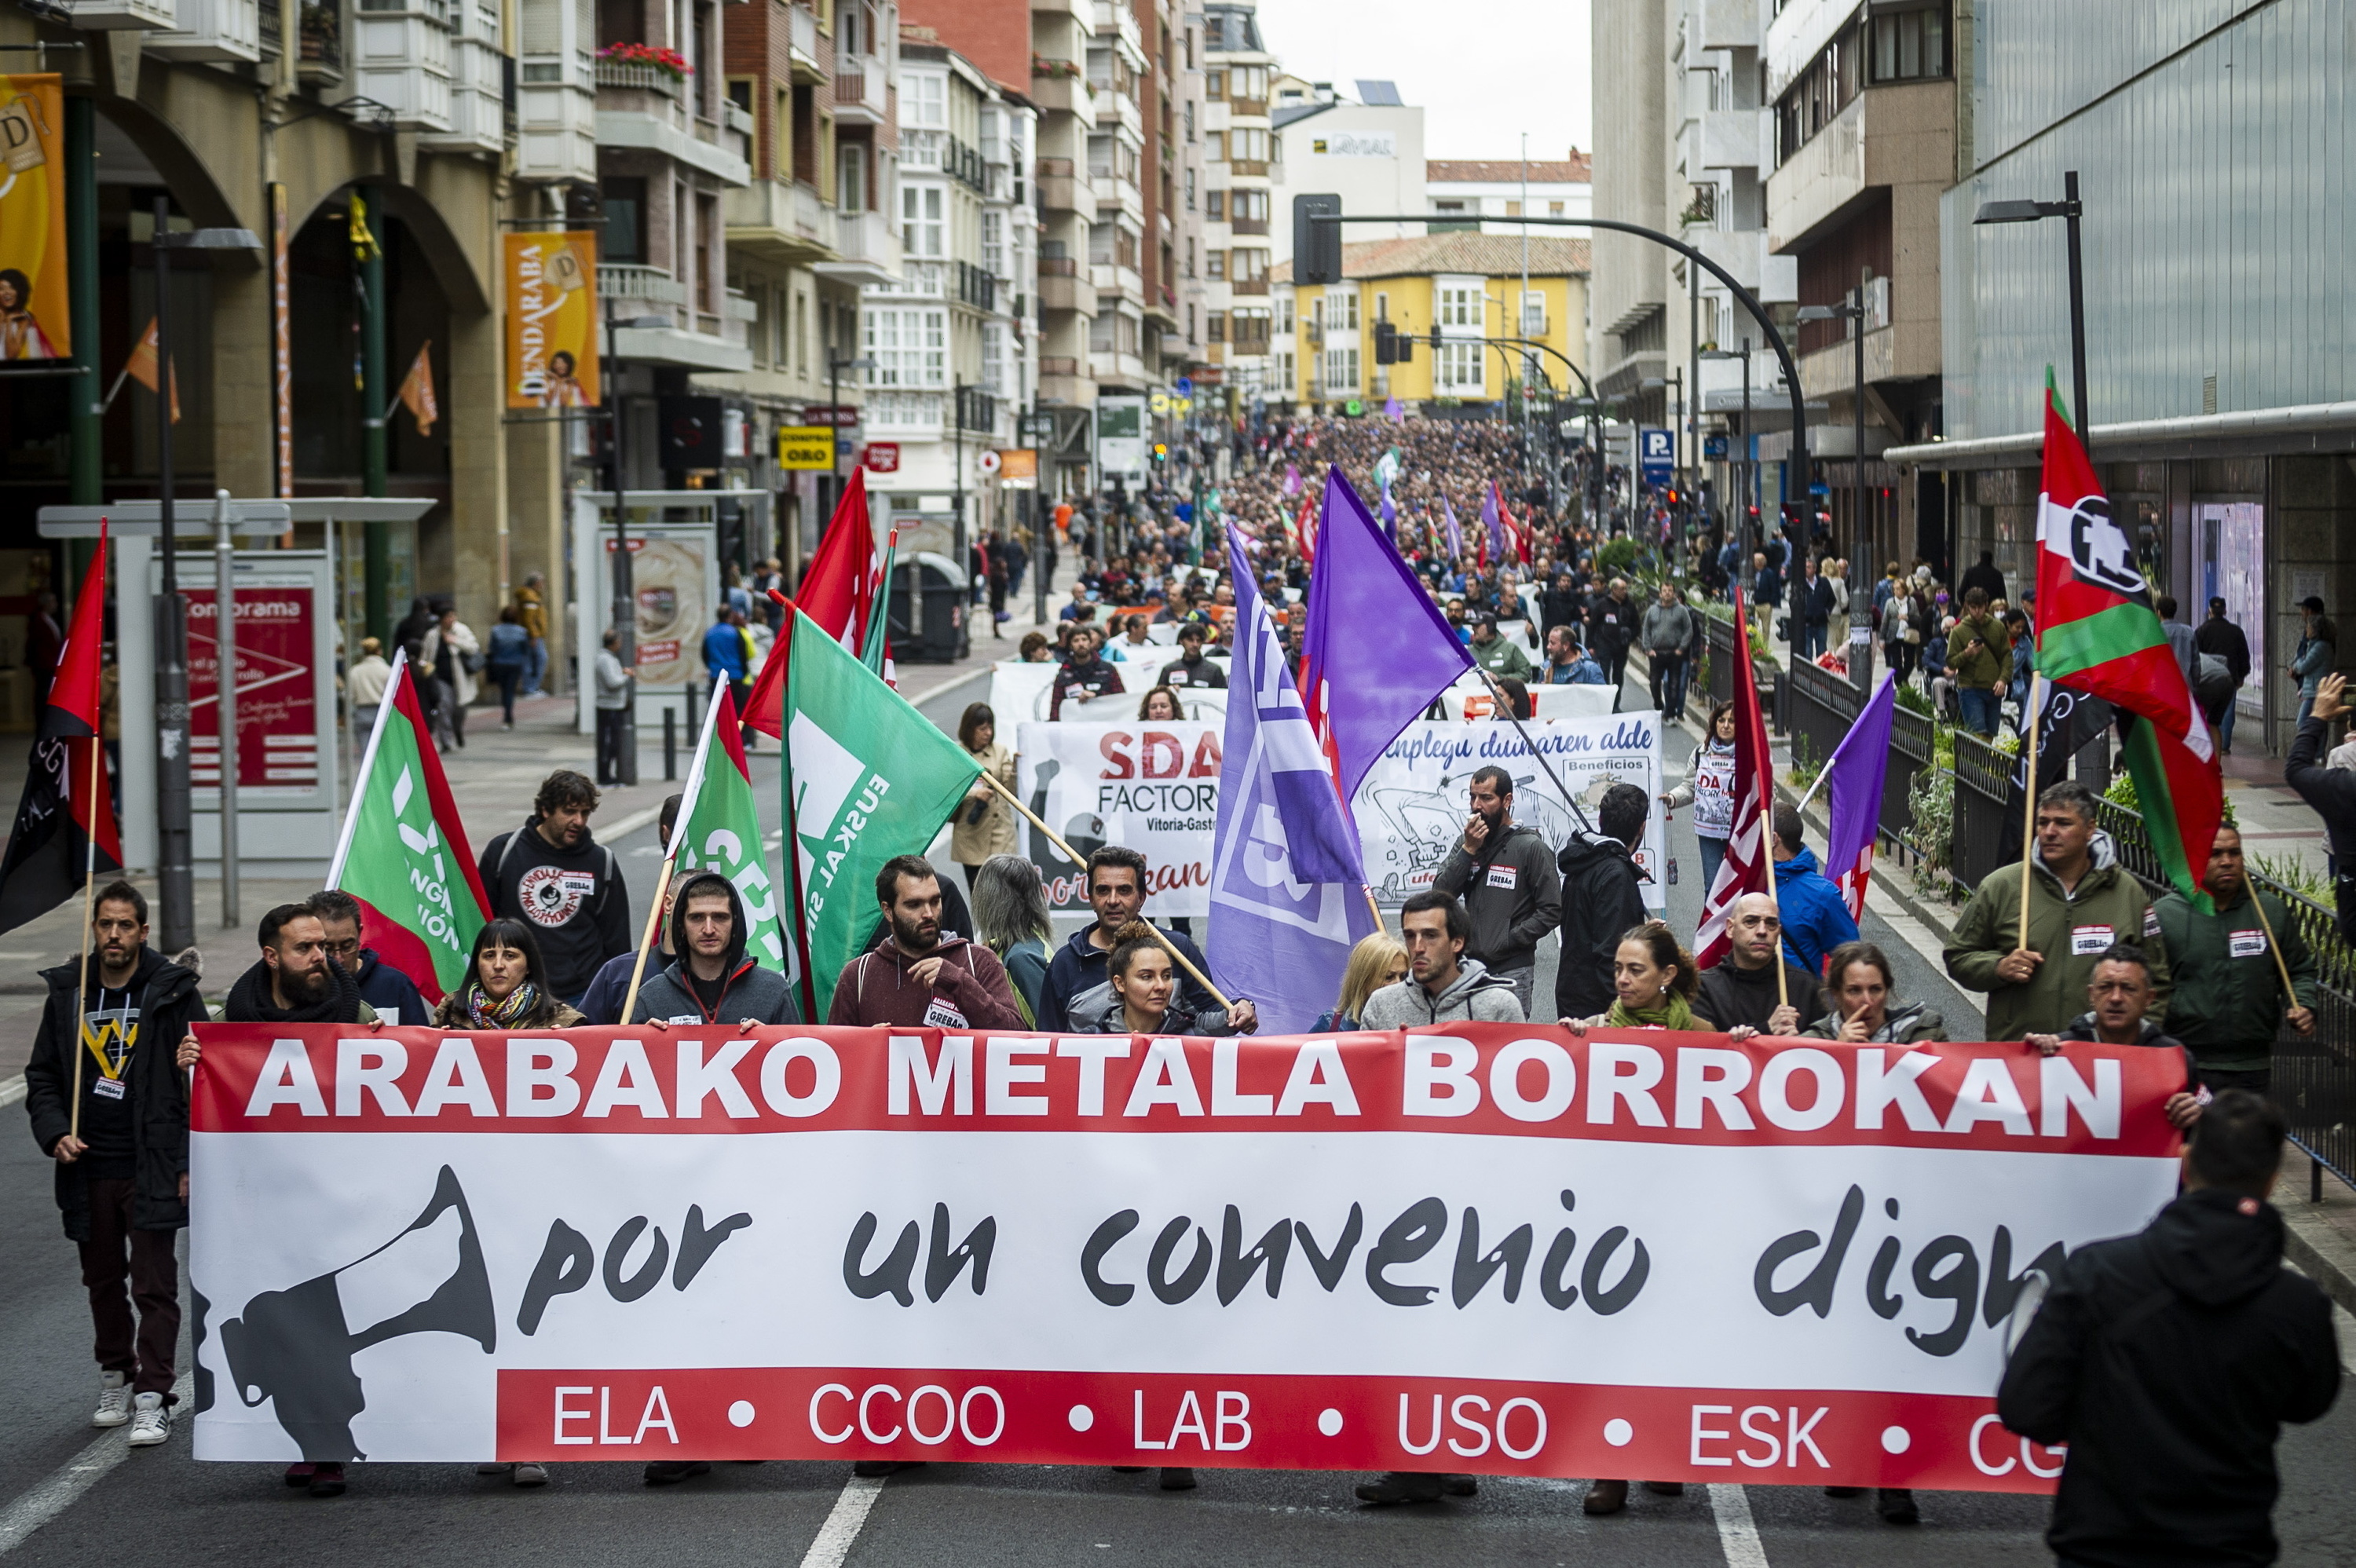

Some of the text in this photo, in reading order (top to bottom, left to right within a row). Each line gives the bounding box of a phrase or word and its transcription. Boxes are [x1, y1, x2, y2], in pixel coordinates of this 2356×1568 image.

[555, 255, 576, 277] D
[518, 244, 549, 396] DENDARABA
[787, 449, 827, 462] ORO
[1650, 433, 1667, 455] P
[186, 601, 301, 617] onorama
[1480, 730, 1593, 758] duinaren
[1600, 720, 1653, 751] alde
[1099, 731, 1222, 780] SDA
[1568, 760, 1644, 772] Beneficios
[1697, 775, 1720, 788] DA
[243, 1033, 2121, 1140] ARABAKO METALA BORROKAN
[516, 1203, 753, 1336] por
[843, 1201, 997, 1307] un
[1080, 1188, 1651, 1316] convenio
[553, 1385, 679, 1446] ELA
[808, 1382, 1006, 1447] CCOO
[1133, 1388, 1253, 1452] LAB
[1398, 1392, 1549, 1460] USO
[1689, 1403, 1831, 1470] ESK
